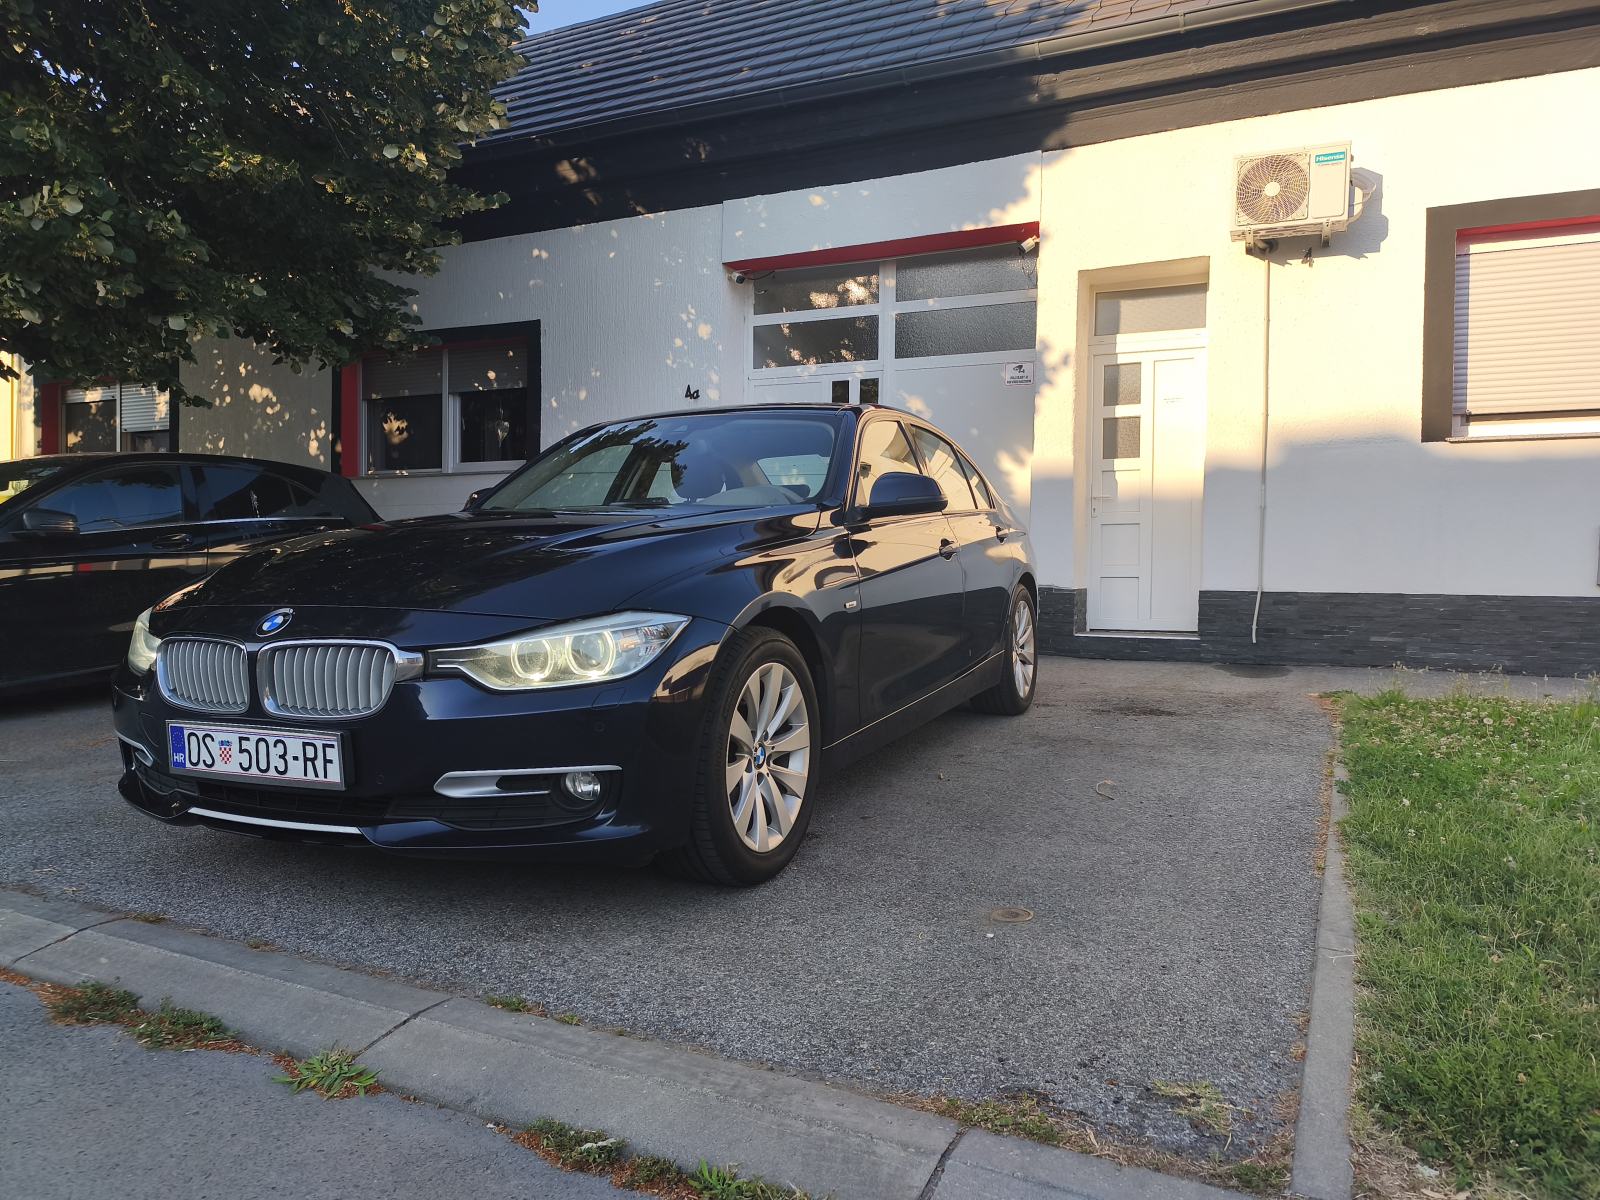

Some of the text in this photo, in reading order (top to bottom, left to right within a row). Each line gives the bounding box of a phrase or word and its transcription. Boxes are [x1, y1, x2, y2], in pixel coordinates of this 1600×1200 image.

[685, 384, 700, 399] 4a
[173, 752, 185, 763] HR
[187, 732, 335, 779] OS 503-RF
